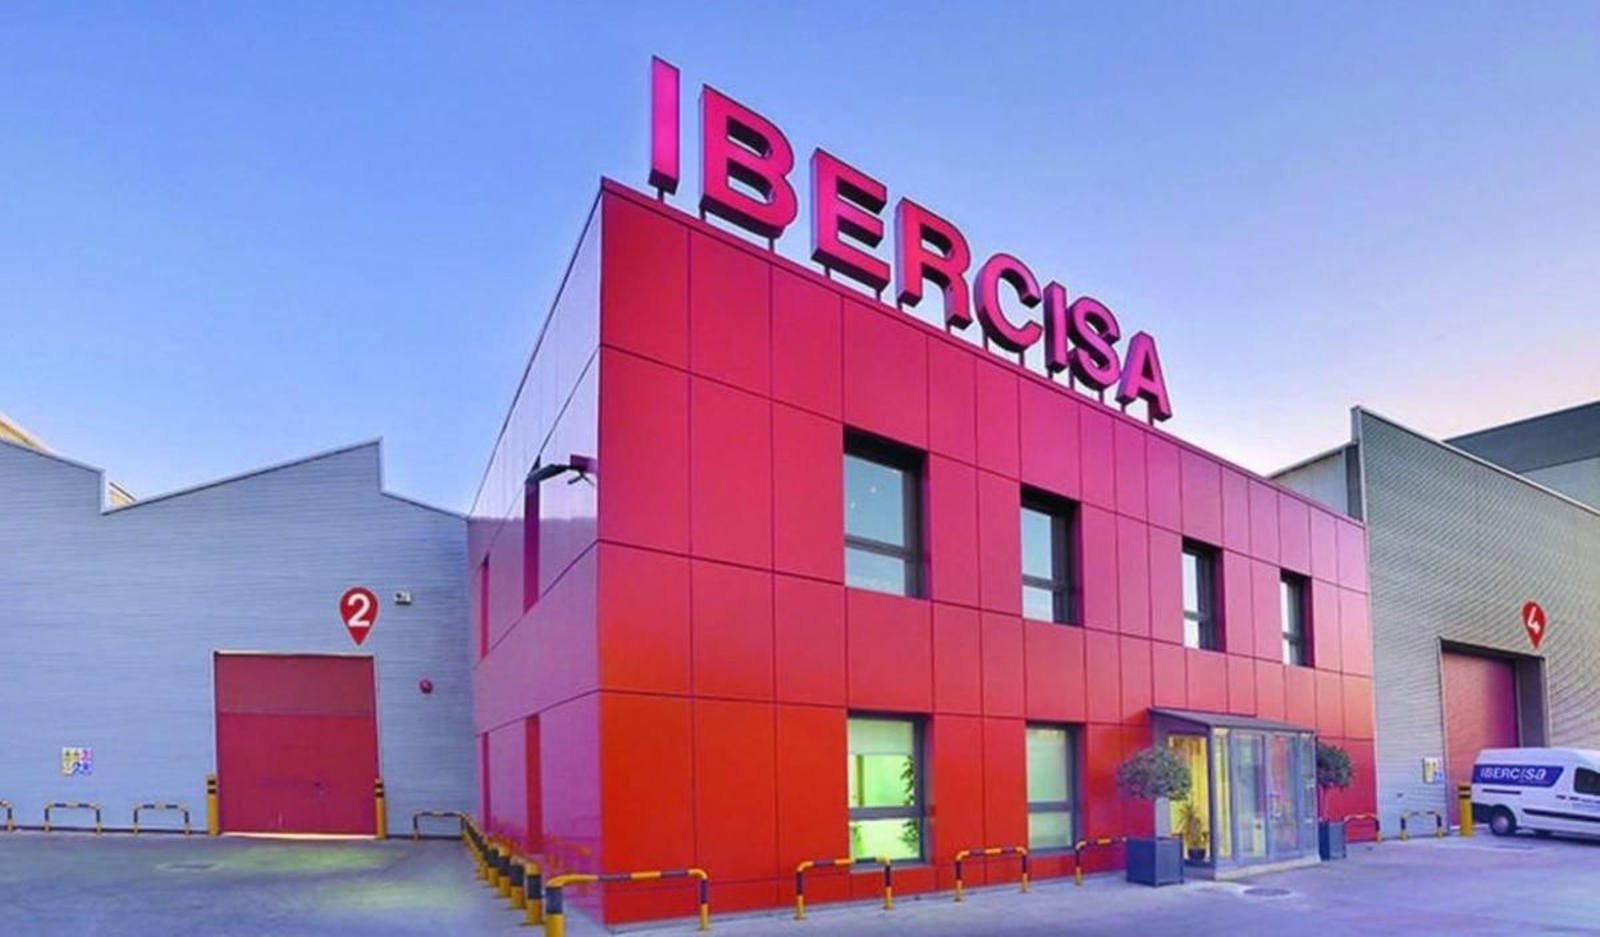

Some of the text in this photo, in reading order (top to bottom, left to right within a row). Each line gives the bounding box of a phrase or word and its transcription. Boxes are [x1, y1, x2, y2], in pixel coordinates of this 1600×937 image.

[648, 54, 1173, 422] IBERCISA
[348, 593, 370, 627] 2
[1527, 606, 1541, 634] 4
